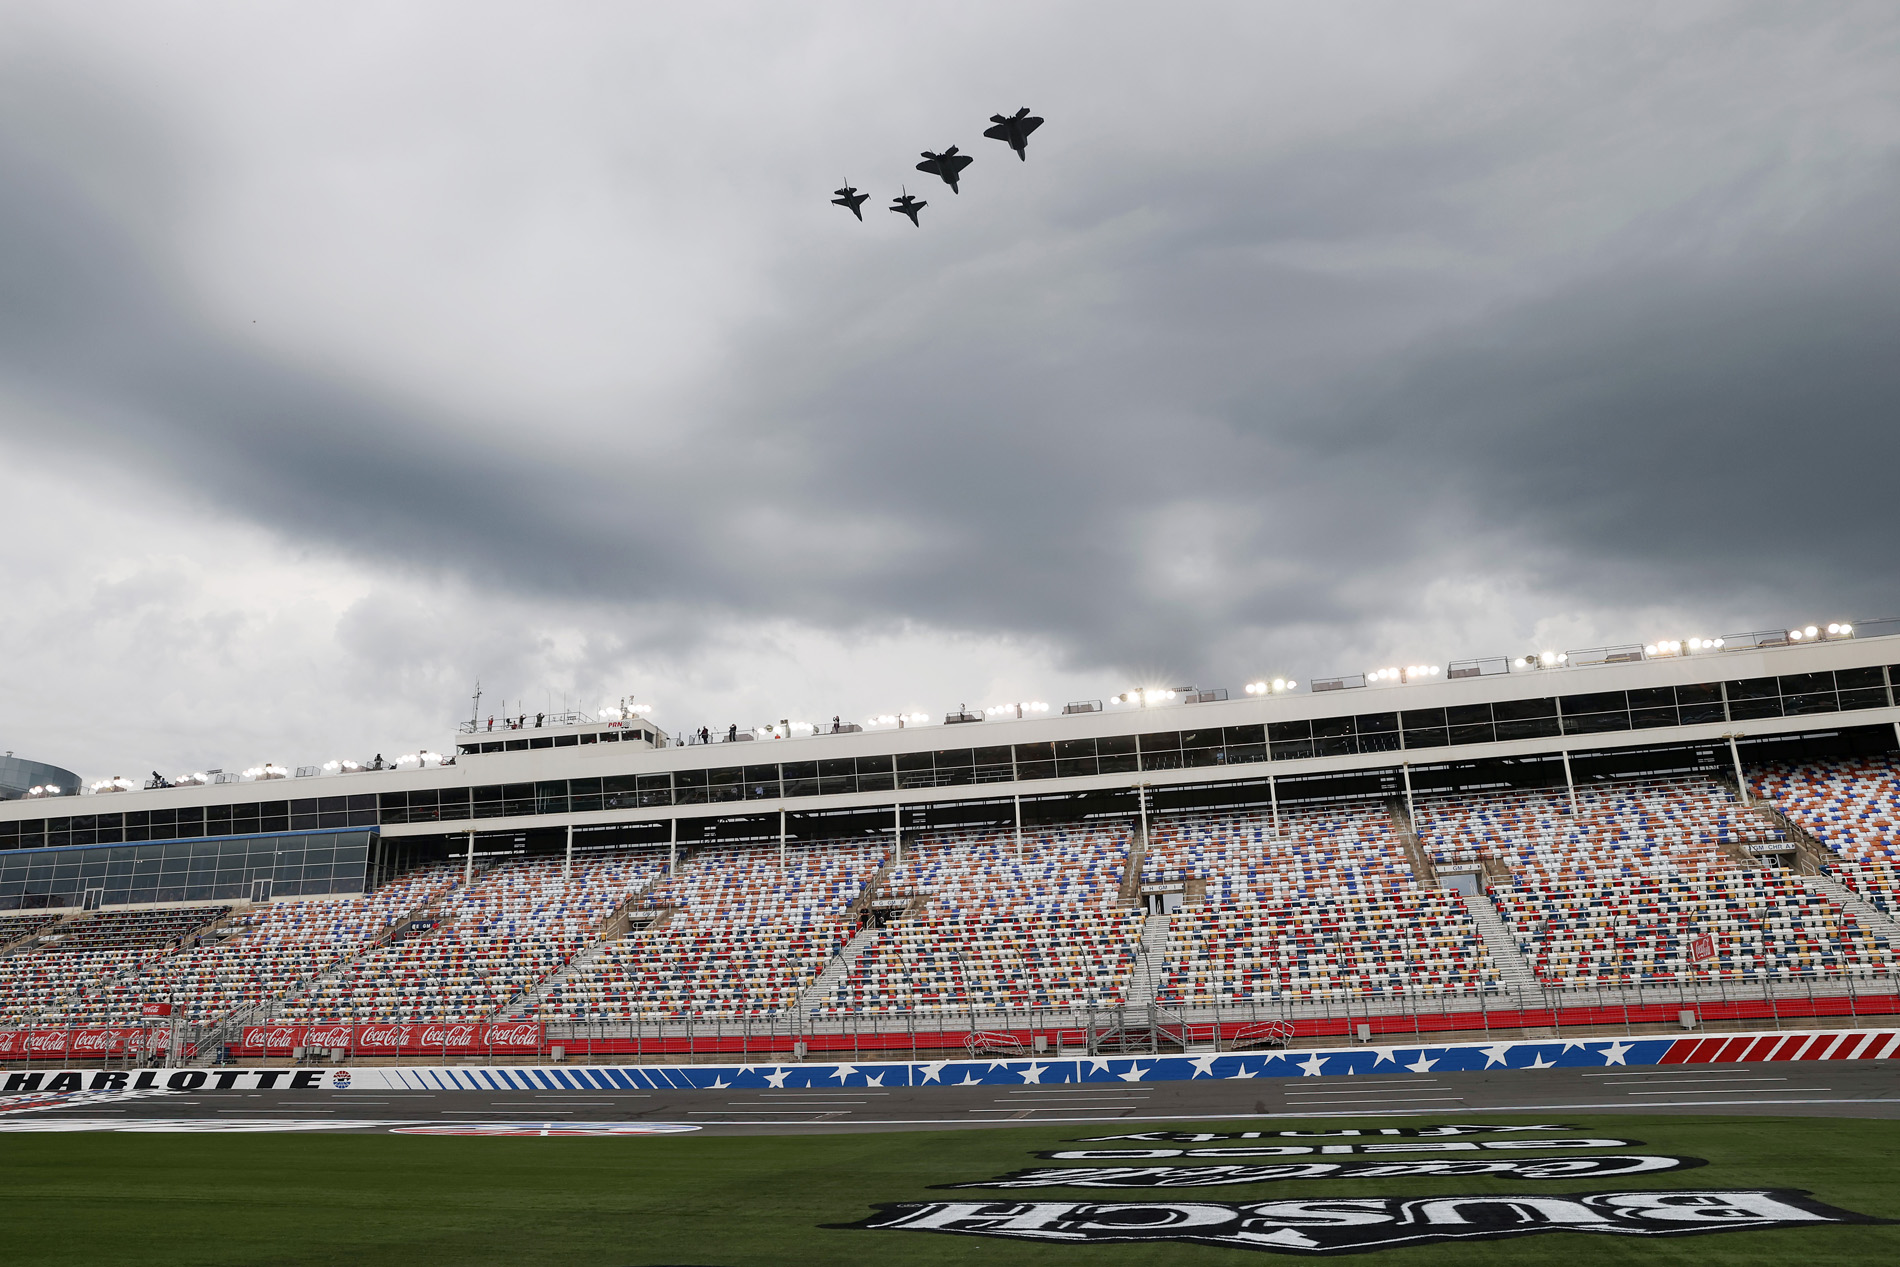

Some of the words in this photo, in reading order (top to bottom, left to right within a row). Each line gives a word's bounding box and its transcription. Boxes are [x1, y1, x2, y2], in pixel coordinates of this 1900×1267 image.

[23, 1031, 69, 1051] Coca-Cola
[74, 1030, 122, 1050] Coca-Cola
[245, 1028, 296, 1048] Coca-Cola
[302, 1026, 353, 1047] Coca-Cola
[360, 1025, 414, 1047] Coca-Cola
[421, 1025, 477, 1046] Coca-Cola
[484, 1024, 540, 1045] Coca-Cola
[1075, 1124, 1574, 1142] xfinity
[1050, 1139, 1628, 1159] GEICO
[947, 1155, 1681, 1188] Coca-Cola
[867, 1191, 1842, 1231] BUSCH
